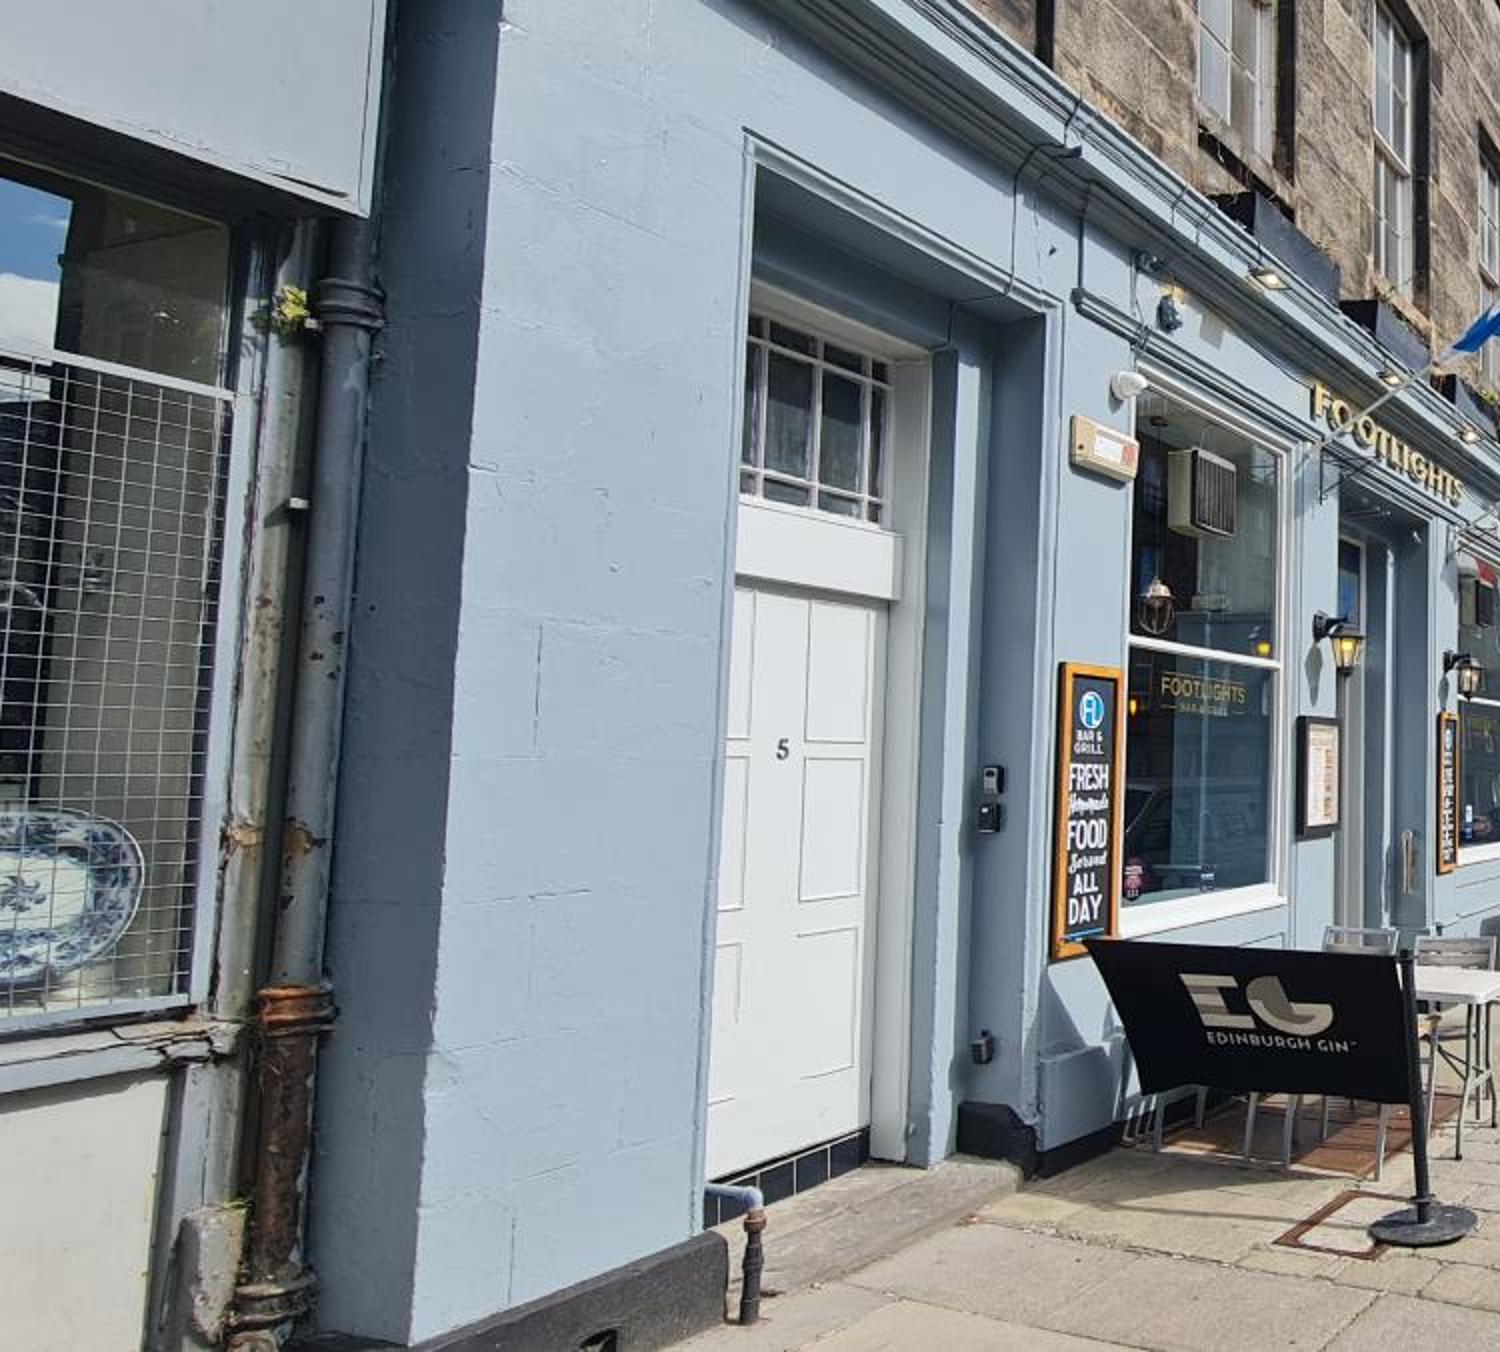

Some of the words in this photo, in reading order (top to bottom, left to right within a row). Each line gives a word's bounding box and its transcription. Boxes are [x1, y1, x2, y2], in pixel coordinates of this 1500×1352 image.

[1312, 383, 1467, 507] FOOTLIGHTS
[1161, 676, 1246, 705] FOOTLIGHTS
[1076, 730, 1094, 741] BAR
[776, 738, 789, 760] 5
[1073, 743, 1104, 755] GRILL
[1069, 763, 1109, 791] FRESH
[1067, 819, 1107, 850] FOOD
[1069, 850, 1107, 874] Served
[1074, 872, 1099, 895] ALL
[1068, 894, 1103, 925] DAY
[1206, 1031, 1311, 1050] EDINBURGH
